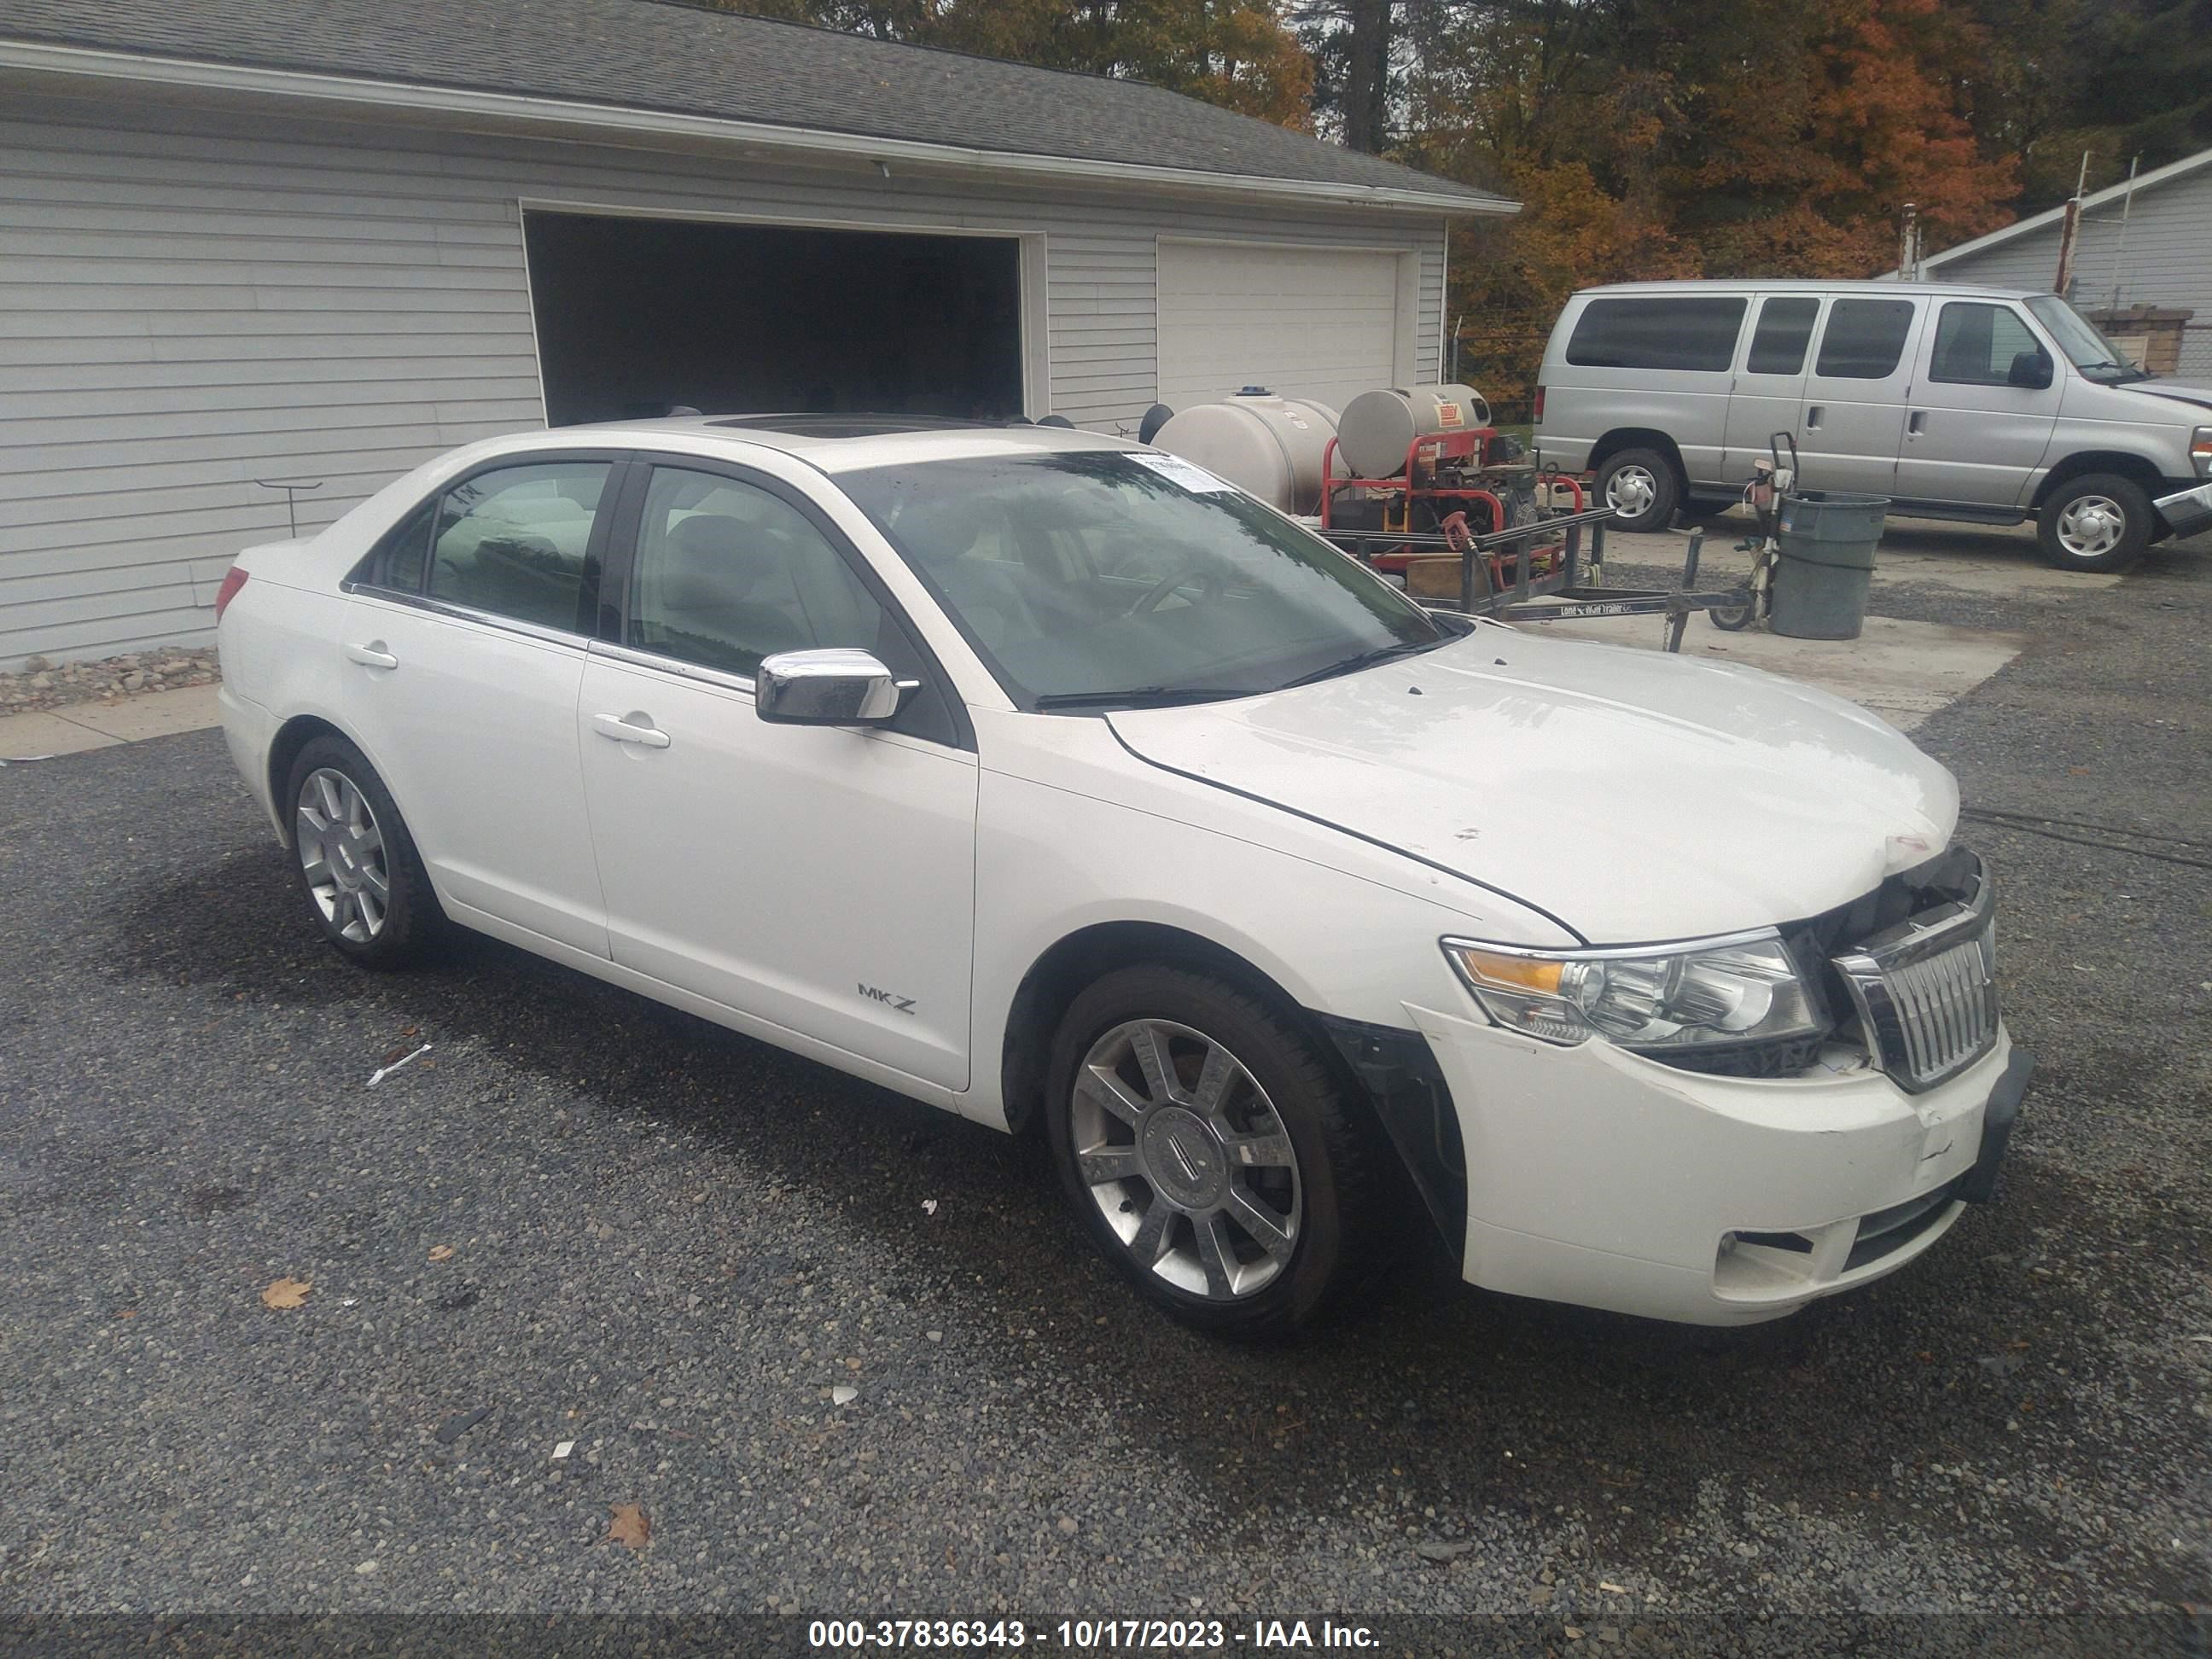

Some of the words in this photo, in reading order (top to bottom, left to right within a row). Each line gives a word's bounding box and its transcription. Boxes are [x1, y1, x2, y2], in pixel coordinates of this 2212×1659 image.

[1561, 606, 1577, 615] Lone
[1586, 604, 1601, 614] Wolf
[1602, 602, 1622, 614] Trailer
[858, 982, 916, 1016] MKZ
